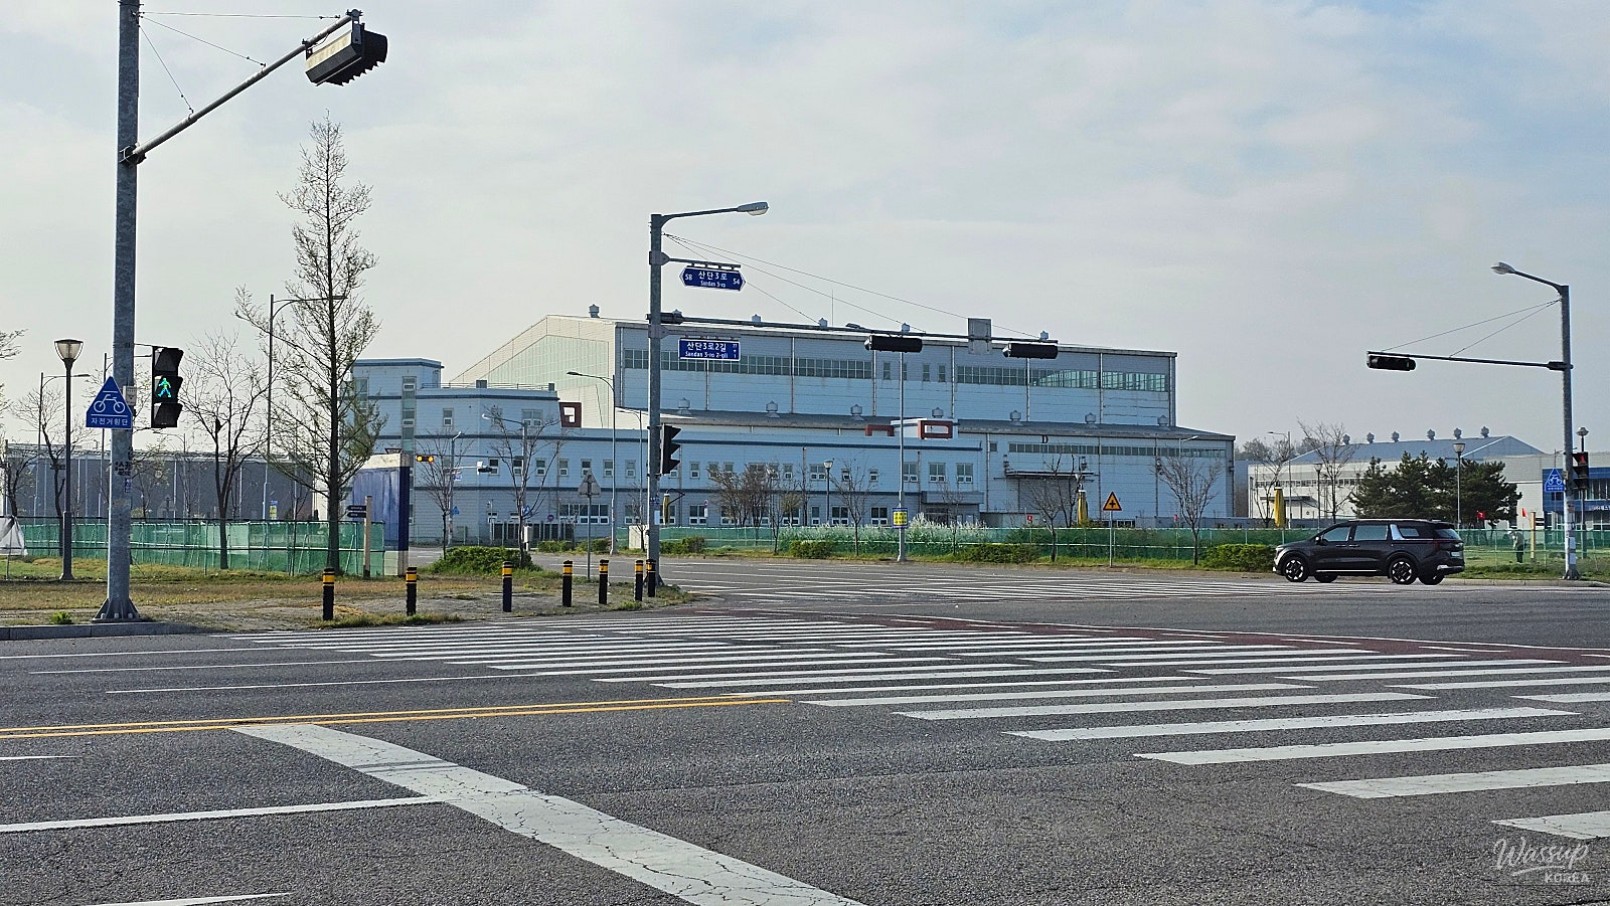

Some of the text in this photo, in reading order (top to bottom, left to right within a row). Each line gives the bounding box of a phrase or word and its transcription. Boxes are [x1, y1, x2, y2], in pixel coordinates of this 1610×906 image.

[685, 273, 693, 281] 58
[698, 271, 728, 280] 산단3로
[687, 342, 727, 352] 산단3로2길
[91, 417, 128, 426] 자전거횡단
